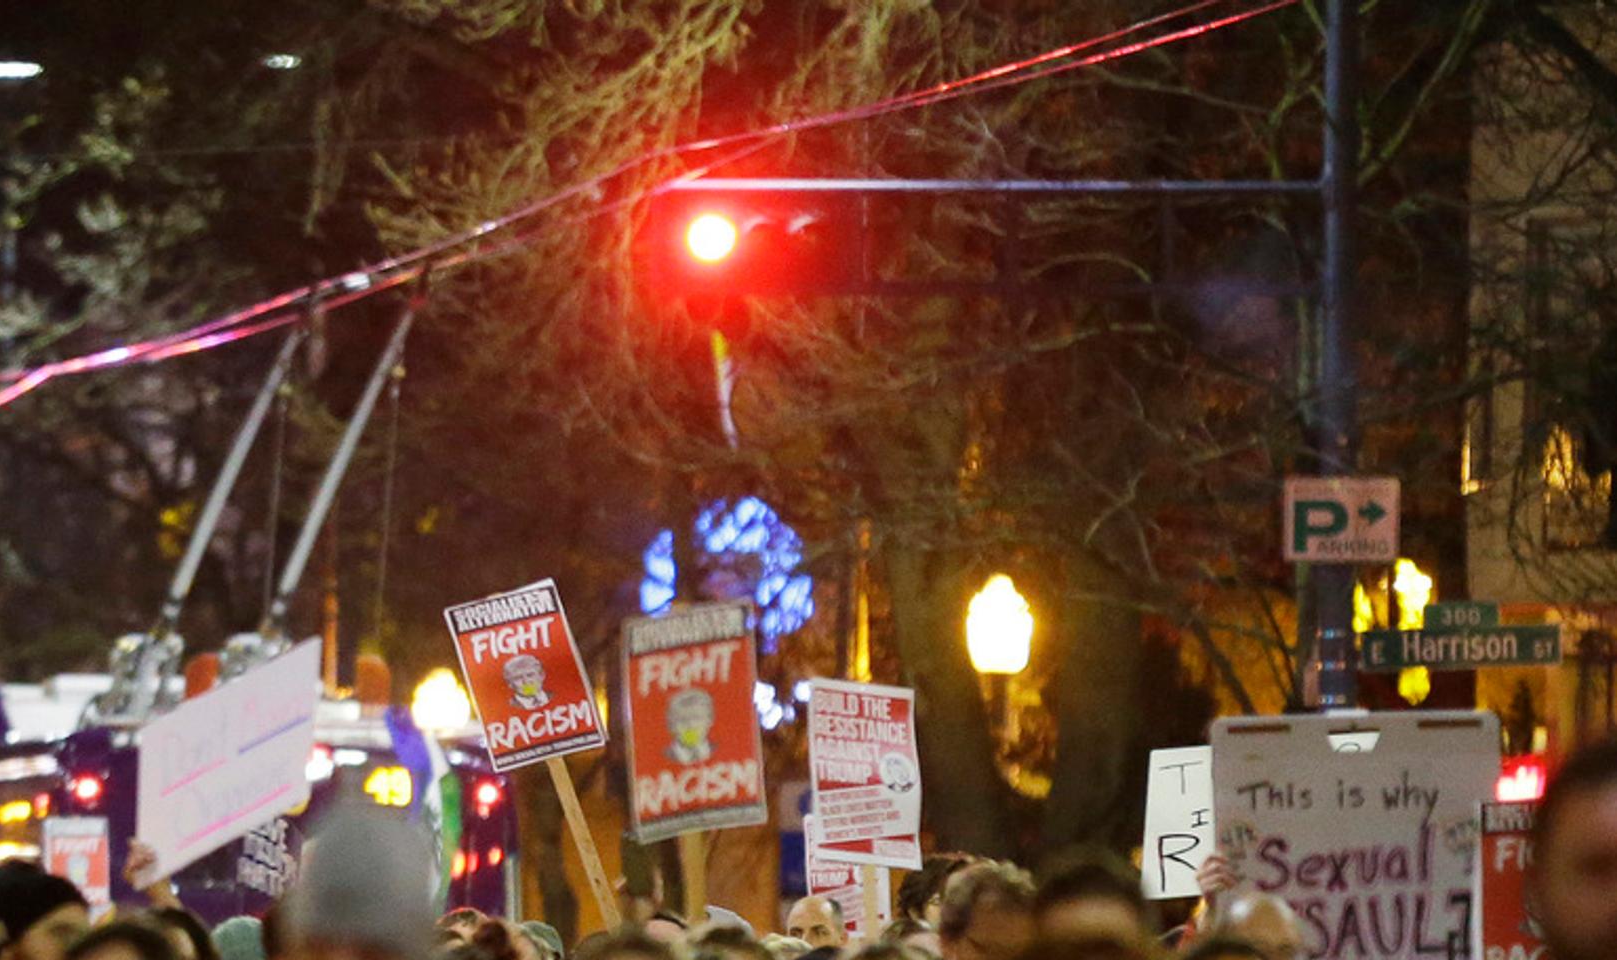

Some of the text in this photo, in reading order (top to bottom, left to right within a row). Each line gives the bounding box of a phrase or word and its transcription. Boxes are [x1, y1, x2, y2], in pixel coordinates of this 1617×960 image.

[1441, 608, 1481, 625] 300
[471, 616, 555, 664] FIGHT
[1371, 642, 1384, 663] E
[1402, 633, 1518, 661] Harrison
[639, 641, 743, 697] FIGHT
[486, 700, 594, 750] RACISM
[814, 714, 911, 745] RESISTANCE
[861, 697, 891, 721] THE
[364, 766, 412, 807] 49
[638, 759, 759, 815] RACISM
[816, 759, 872, 785] TRUMP
[1236, 770, 1440, 819] This is why
[1255, 820, 1438, 893] Sexual
